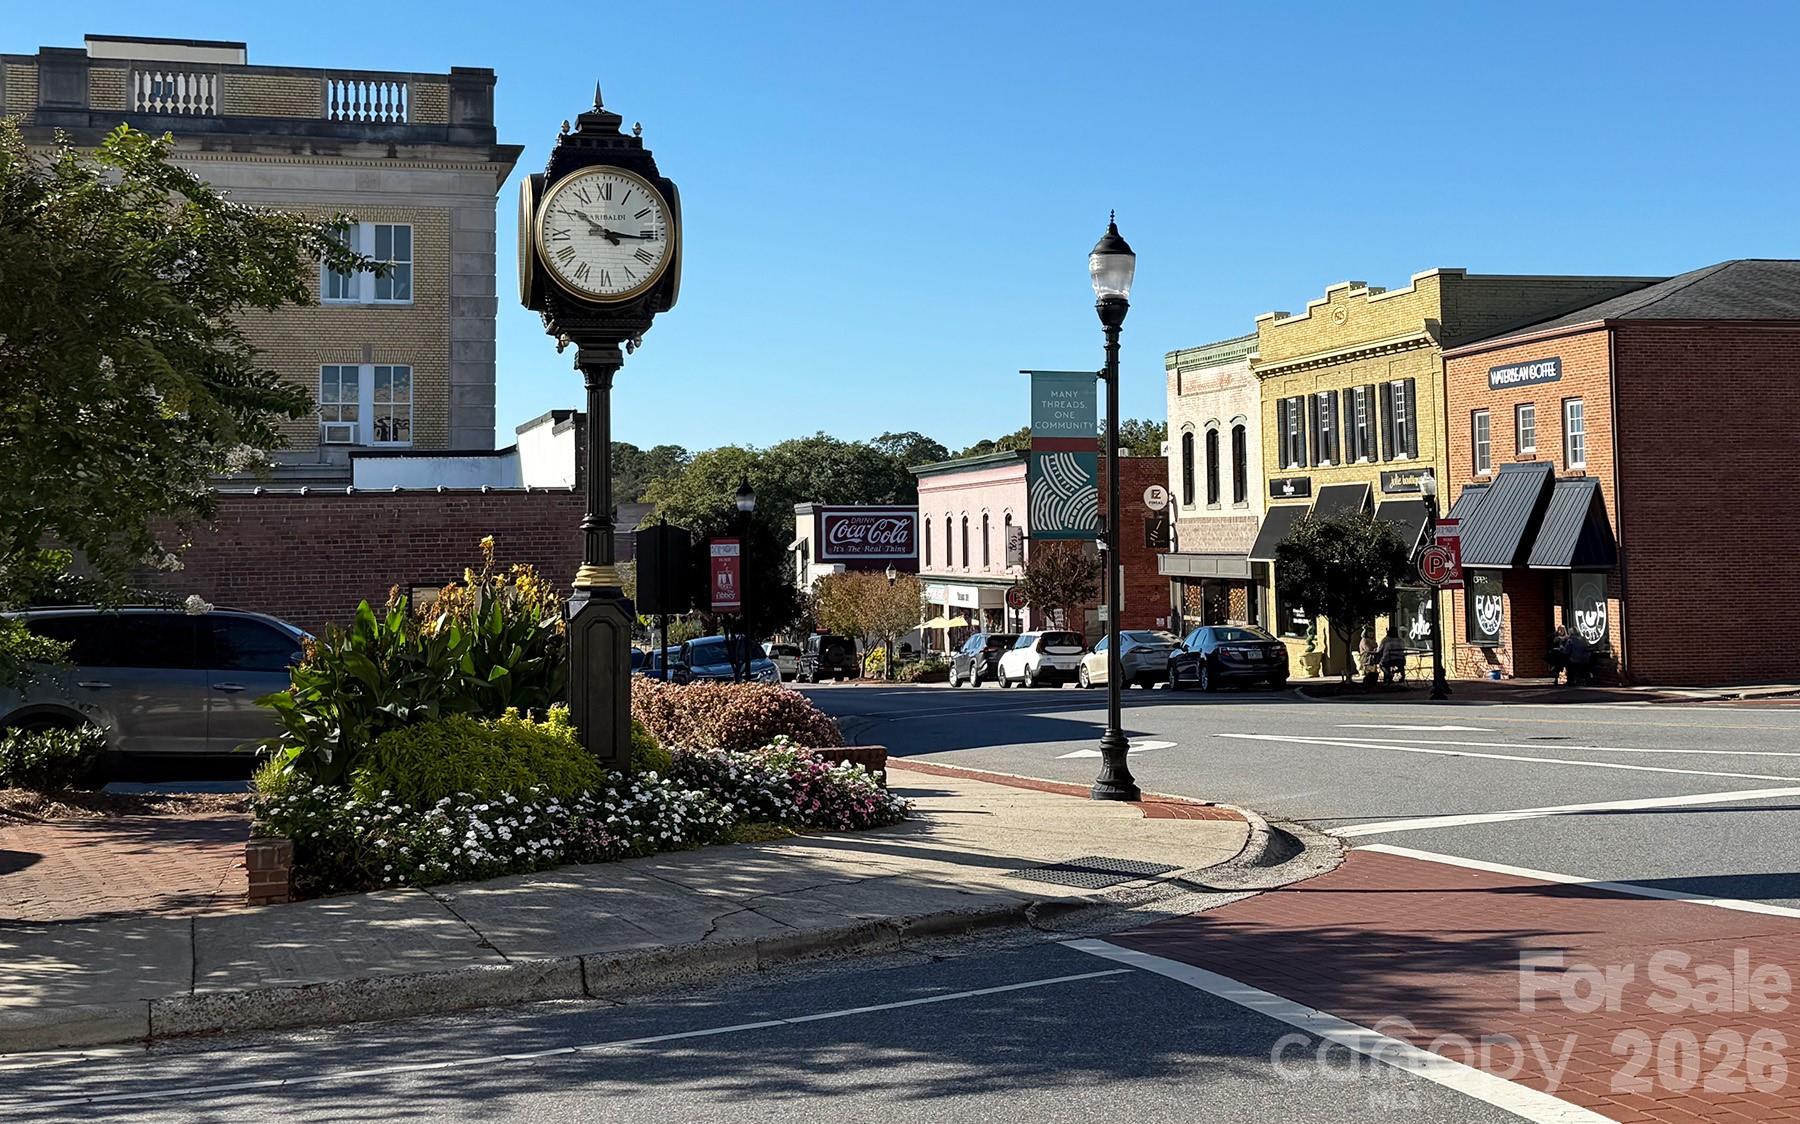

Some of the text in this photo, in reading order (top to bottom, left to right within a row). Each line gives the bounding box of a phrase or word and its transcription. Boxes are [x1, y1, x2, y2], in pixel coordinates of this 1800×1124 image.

[639, 230, 659, 241] II
[1050, 390, 1078, 399] MANY
[1054, 411, 1076, 420] ONE
[1034, 421, 1095, 431] COMMUNITY
[829, 518, 911, 545] Coca-Cola
[848, 545, 861, 553] The
[864, 545, 881, 553] Real
